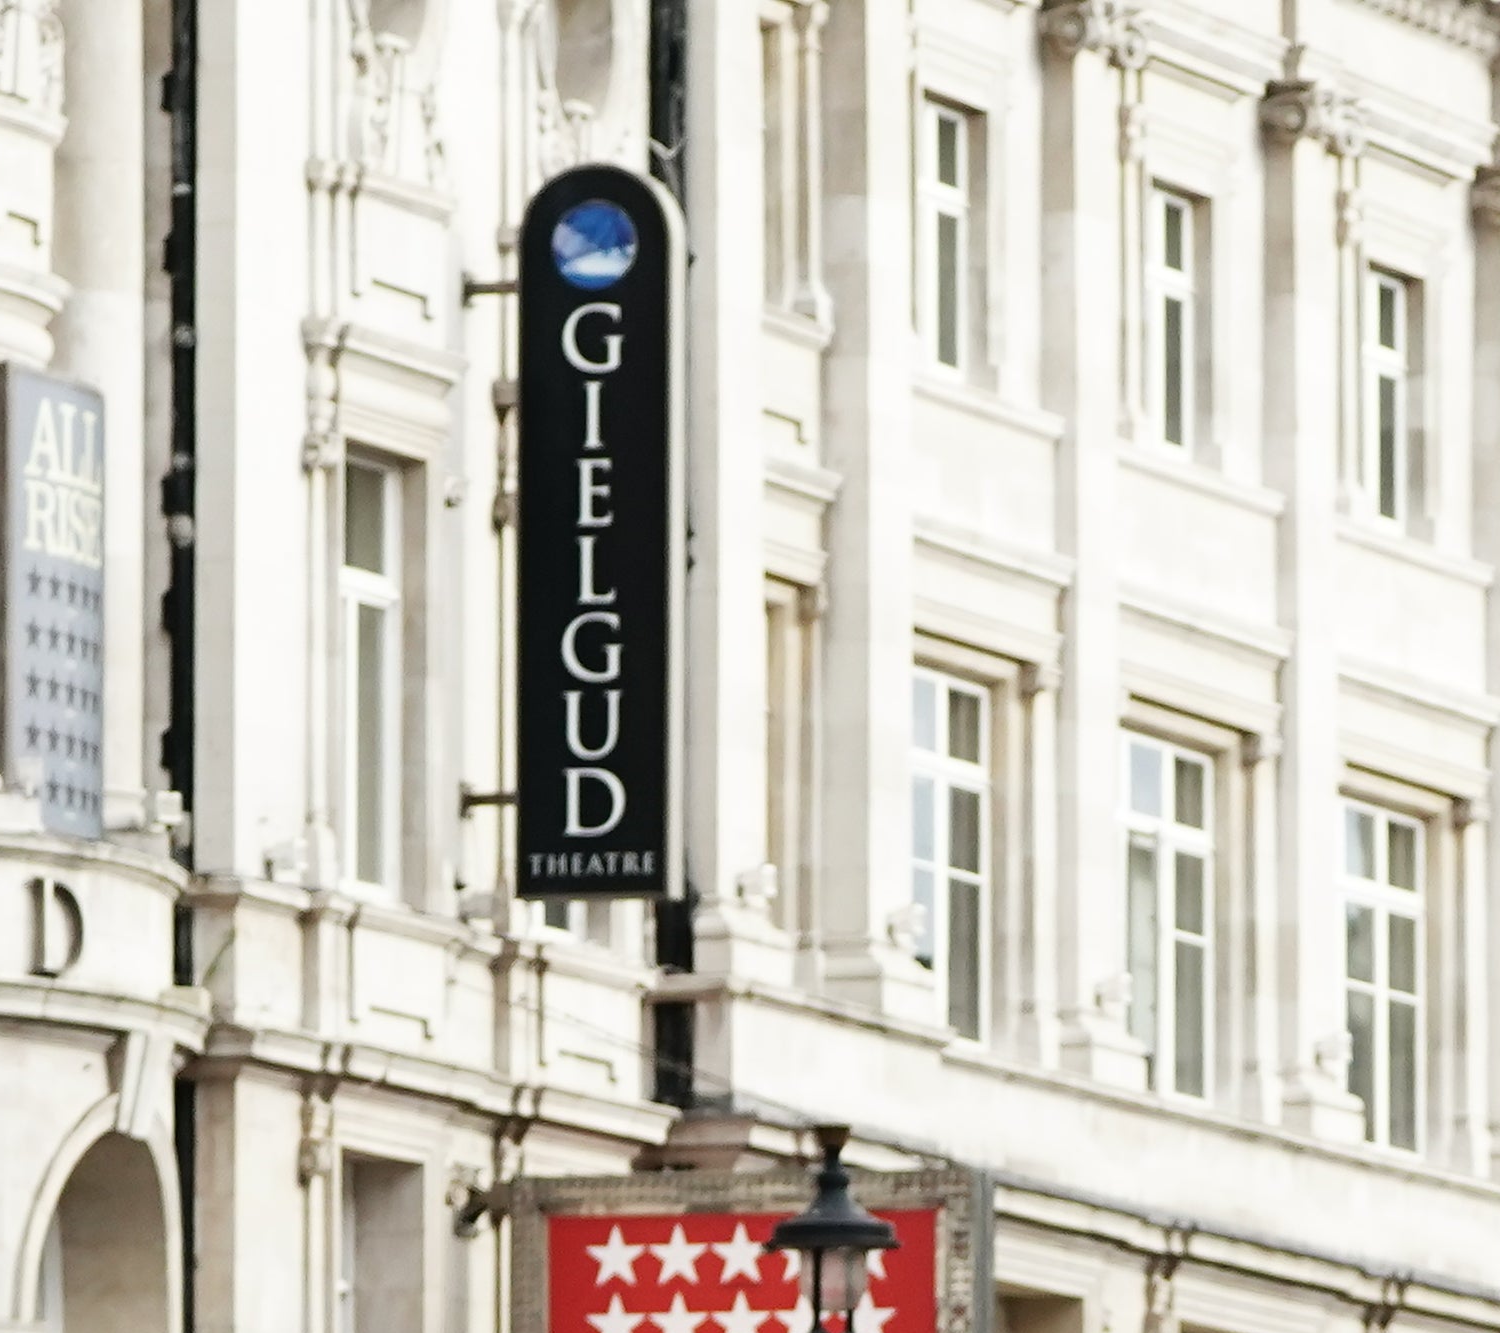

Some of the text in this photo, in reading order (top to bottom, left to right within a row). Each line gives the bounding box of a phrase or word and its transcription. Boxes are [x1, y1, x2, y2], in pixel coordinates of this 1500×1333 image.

[23, 396, 101, 493] ALL
[23, 478, 102, 569] RISE
[561, 302, 627, 838] GIELGUD
[529, 852, 657, 878] THEATRE
